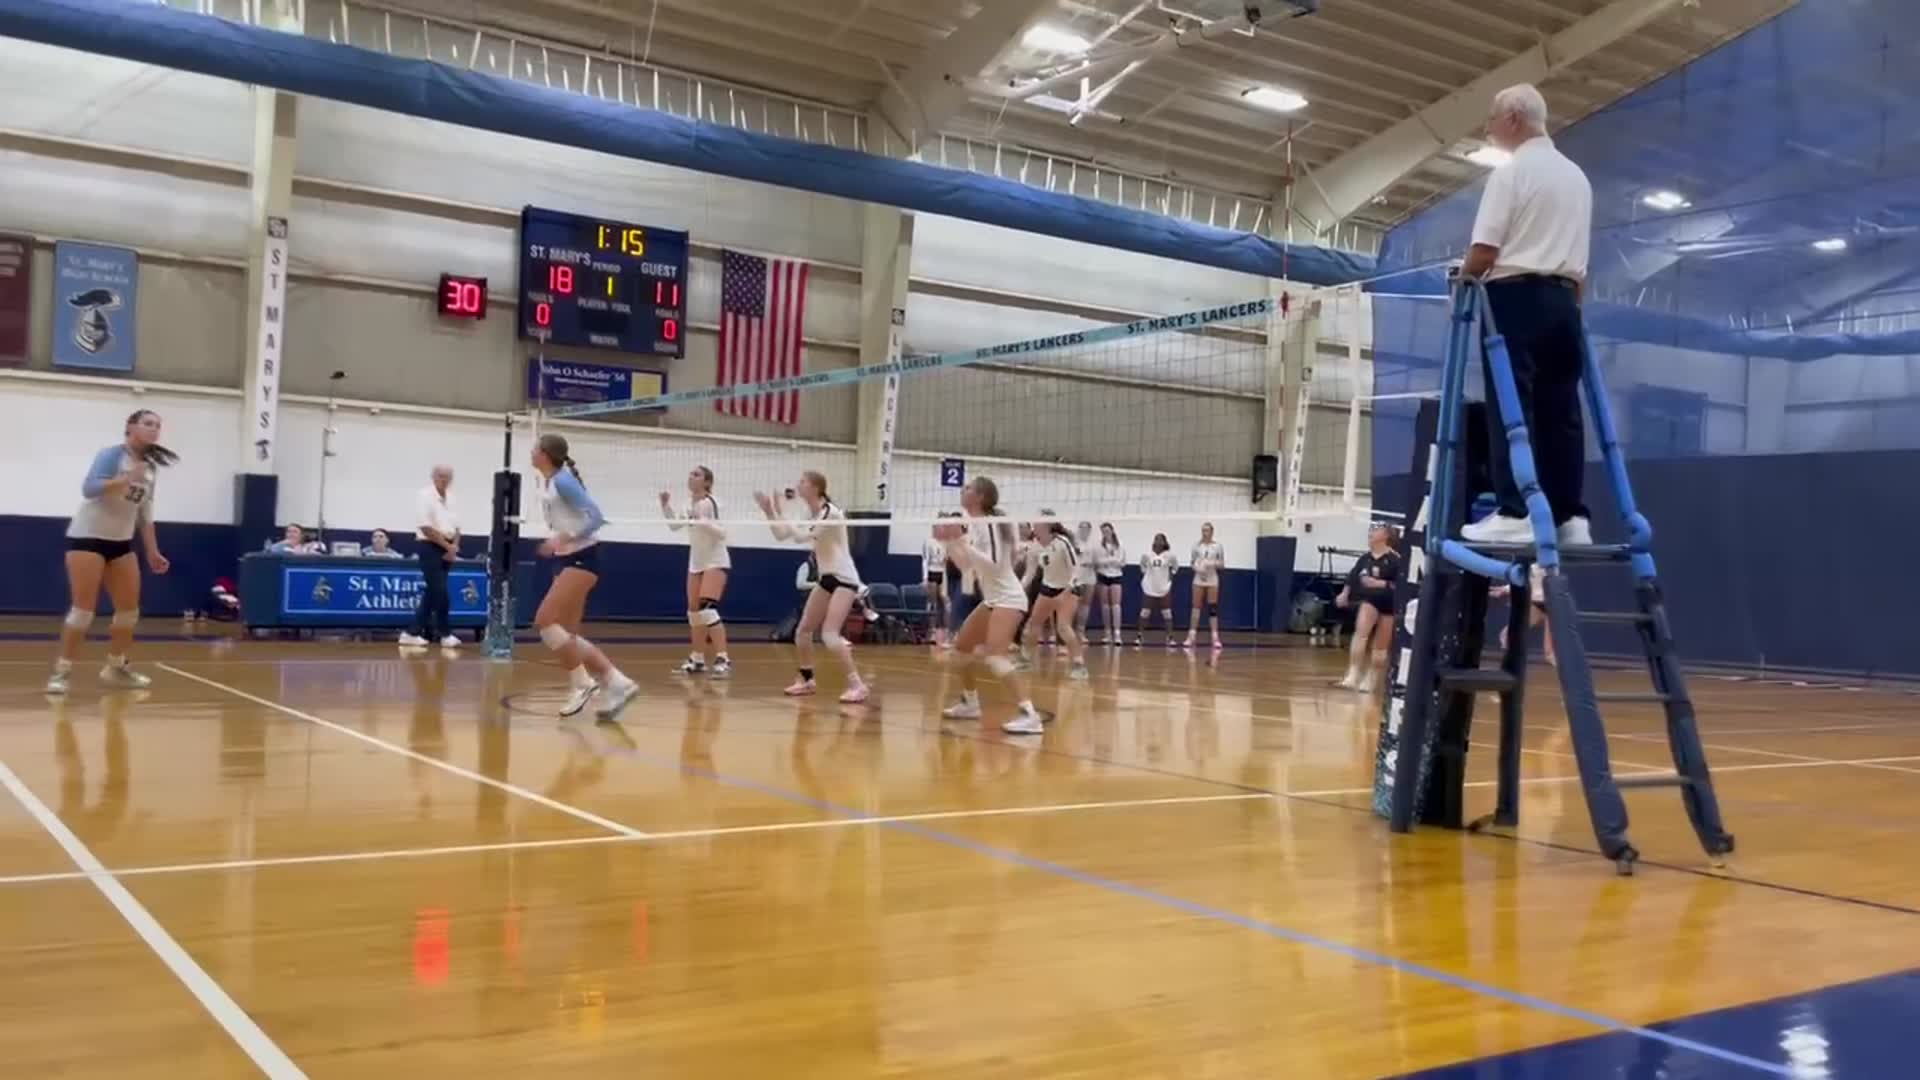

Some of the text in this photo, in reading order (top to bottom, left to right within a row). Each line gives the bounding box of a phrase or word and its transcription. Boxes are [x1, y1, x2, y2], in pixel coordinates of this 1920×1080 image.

[598, 225, 644, 256] 1:15
[530, 244, 592, 266] ST. MARY'S
[549, 265, 573, 293] 18
[641, 262, 678, 277] GUEST
[447, 281, 480, 312] 30
[607, 276, 613, 296] 1
[656, 281, 678, 306] 11
[536, 303, 550, 325] 0
[1127, 300, 1267, 335] ST. MARY'S LANCERS
[663, 319, 677, 340] 0
[975, 332, 1085, 360] ST. MARY'S LANCERS
[947, 468, 959, 485] 2
[348, 576, 374, 592] St.
